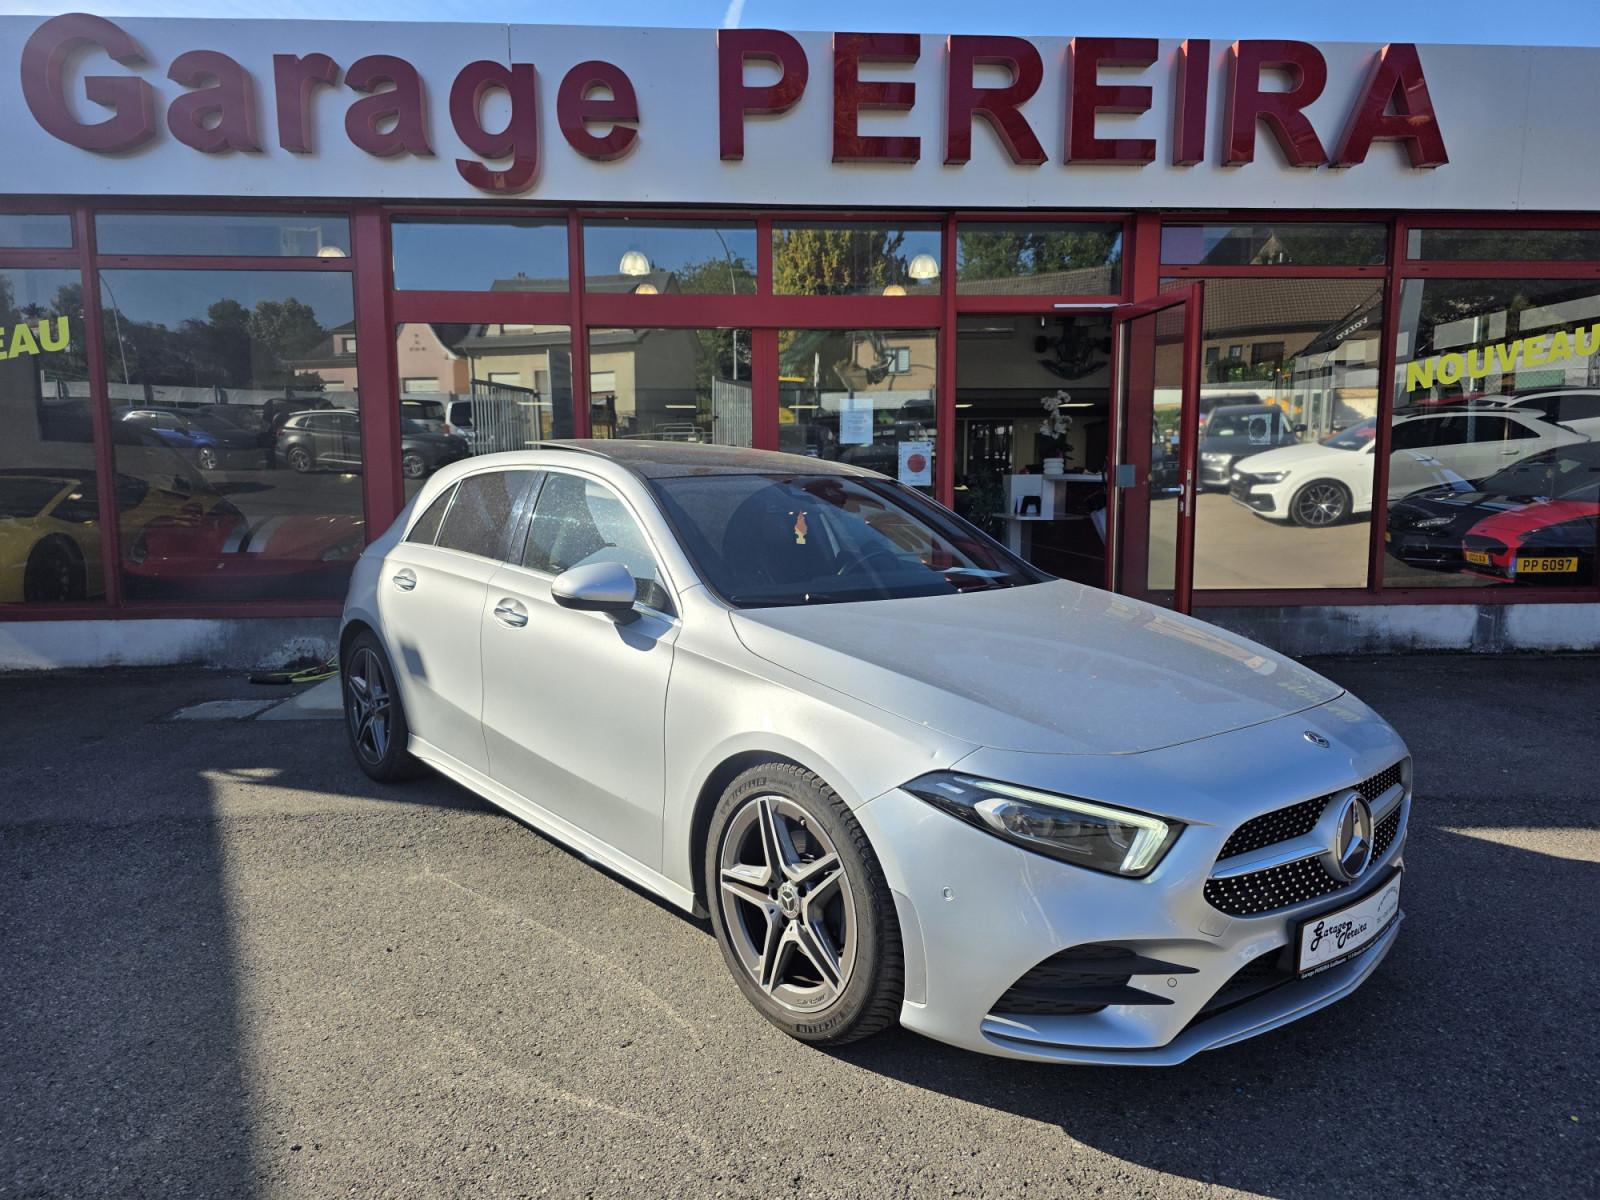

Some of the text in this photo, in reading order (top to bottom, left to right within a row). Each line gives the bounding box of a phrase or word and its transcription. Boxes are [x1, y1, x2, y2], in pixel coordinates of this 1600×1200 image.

[20, 13, 1449, 195] Garage PEREIRA
[1406, 323, 1600, 393] NOUVEAU
[1523, 559, 1572, 571] PP 6097
[1310, 921, 1346, 951] Garage
[1337, 921, 1367, 949] Pereira
